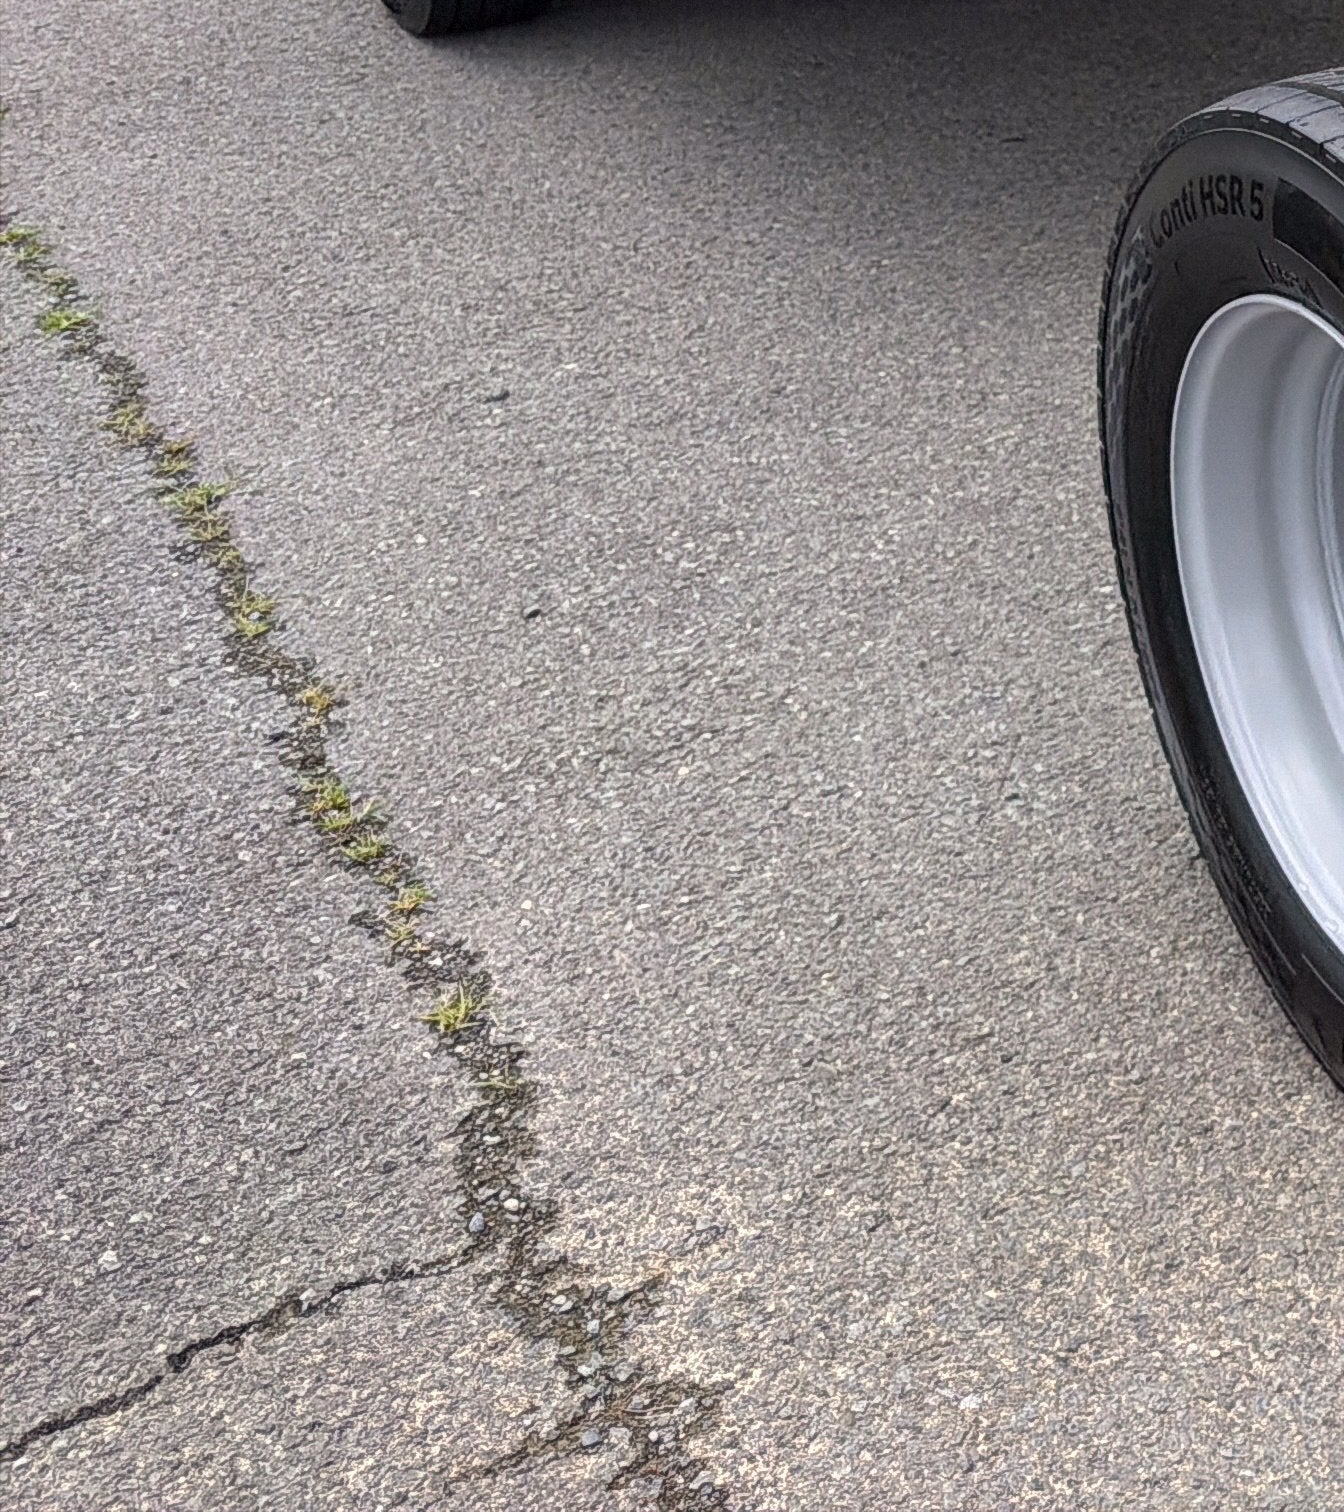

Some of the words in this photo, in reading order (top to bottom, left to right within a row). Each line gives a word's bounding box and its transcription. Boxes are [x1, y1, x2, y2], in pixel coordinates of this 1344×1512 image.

[1149, 180, 1197, 248] Conti
[1200, 174, 1245, 217] HSR
[1250, 179, 1264, 222] 5
